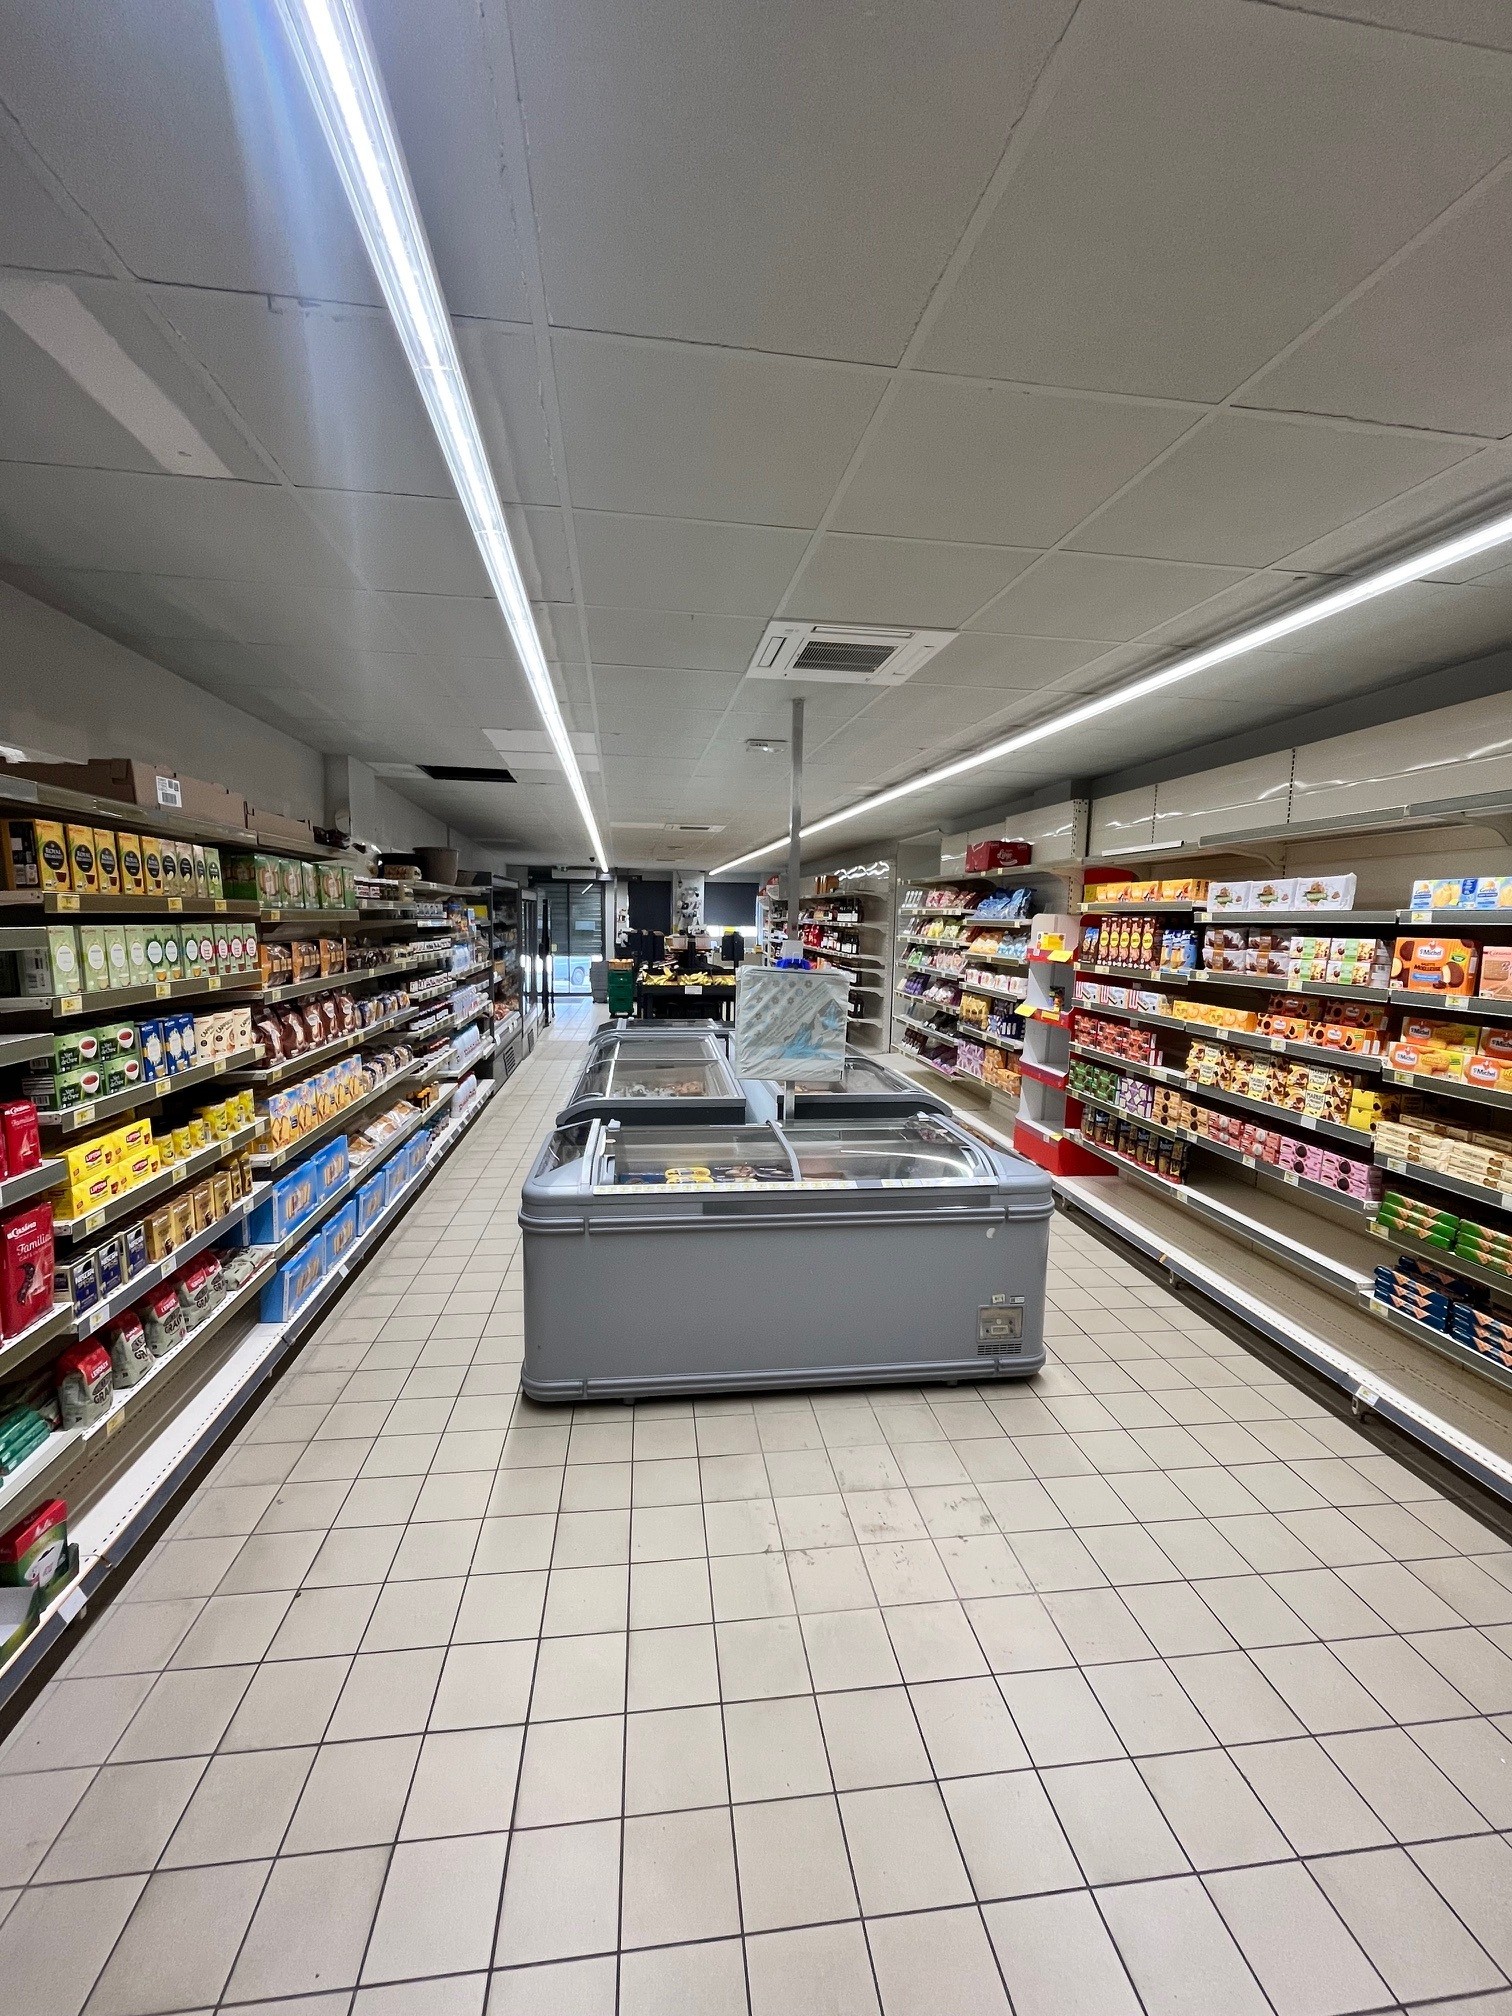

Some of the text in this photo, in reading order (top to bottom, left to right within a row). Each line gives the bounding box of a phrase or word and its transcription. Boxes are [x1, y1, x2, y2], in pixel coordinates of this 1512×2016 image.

[1424, 948, 1442, 956] Michel
[1476, 1069, 1496, 1077] Michel
[12, 1221, 37, 1239] Casino
